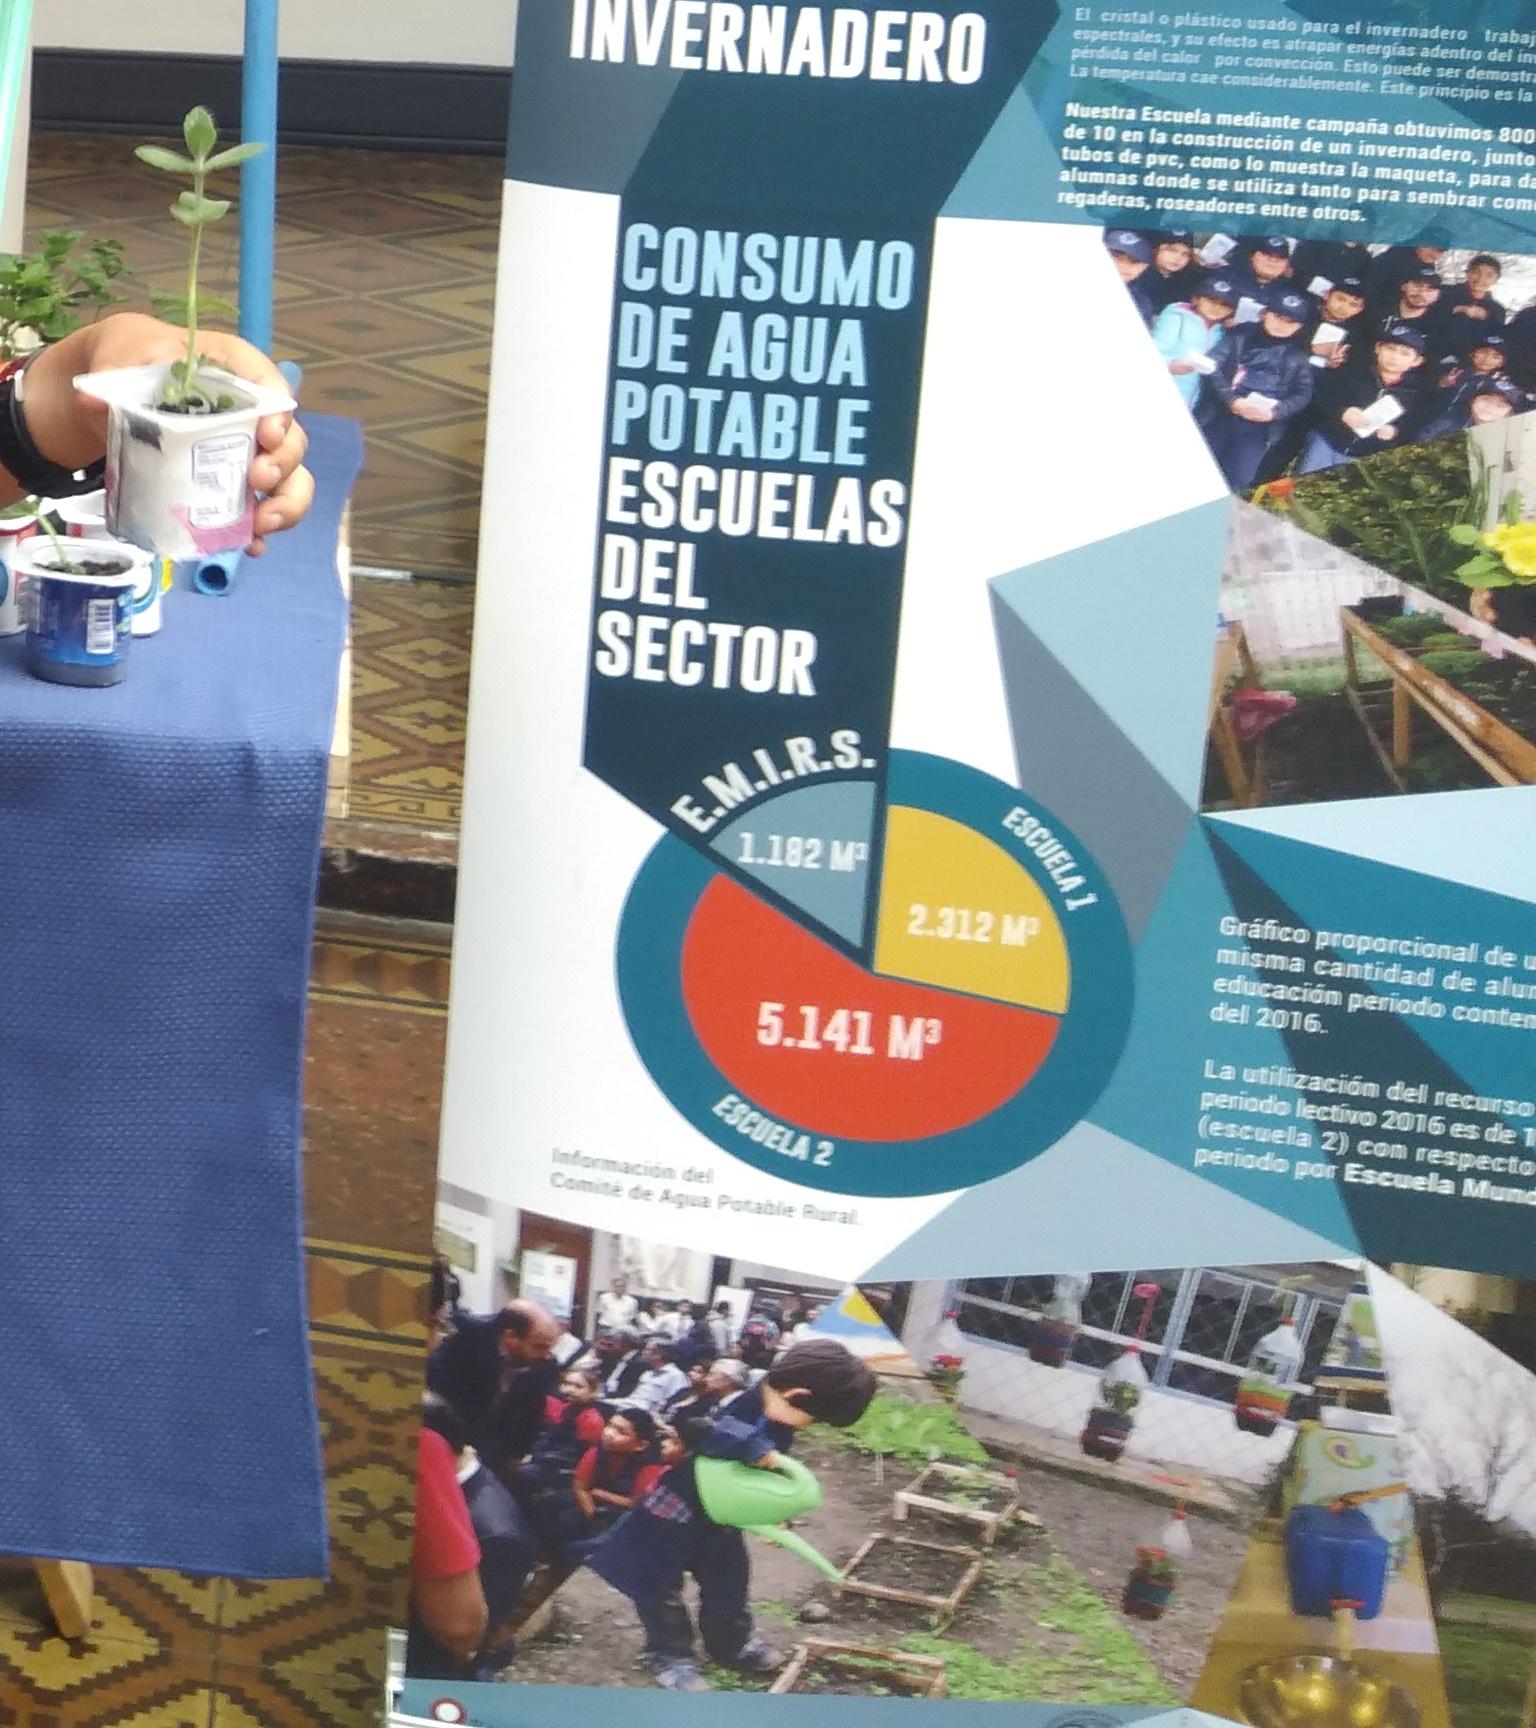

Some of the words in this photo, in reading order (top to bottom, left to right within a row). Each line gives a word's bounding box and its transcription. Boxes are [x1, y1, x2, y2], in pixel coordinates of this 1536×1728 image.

[1064, 123, 1088, 140] de
[1093, 124, 1115, 142] 10
[1121, 130, 1145, 143] en
[1148, 127, 1168, 145] la
[1172, 133, 1294, 151] construcción
[1300, 136, 1324, 154] de
[1328, 142, 1352, 155] un
[1358, 140, 1479, 165] invernadero,
[1483, 147, 1535, 168] junto
[1065, 102, 1136, 121] Nuestra
[1140, 106, 1211, 125] Escuela
[1216, 112, 1302, 130] mediante
[1305, 118, 1388, 136] campaña
[1394, 120, 1494, 141] obtuvimos
[1497, 126, 1536, 144] 800
[1060, 167, 1138, 186] alumnas
[1143, 171, 1202, 190] donde
[1206, 178, 1229, 192] se
[1233, 177, 1296, 196] utiliza
[1300, 181, 1351, 199] tanto
[1356, 188, 1401, 204] para
[1406, 189, 1488, 207] sembrar
[1492, 197, 1536, 211] com
[1062, 145, 1114, 163] tubos
[1118, 148, 1143, 165] de
[1144, 153, 1186, 170] pvc,
[1189, 155, 1240, 170] como
[1245, 155, 1264, 172] lo
[1269, 160, 1346, 177] muestra
[1350, 161, 1370, 179] la
[1374, 167, 1463, 187] maqueta,
[1468, 173, 1511, 189] para
[1058, 190, 1153, 211] regaderas,
[1155, 197, 1258, 215] roseadores
[1260, 203, 1308, 218] entre
[1313, 203, 1367, 222] otros.
[621, 223, 914, 311] CONSUMO
[617, 302, 691, 373] DE
[708, 311, 866, 386] AGUA
[611, 378, 869, 466] POTABLE
[604, 457, 905, 548] ESCUELAS
[601, 534, 707, 609] DEL
[596, 611, 816, 696] SECTOR
[670, 729, 877, 833] E.M.I.R.S.
[739, 833, 822, 868] 1.182
[1000, 806, 1087, 895] ESCUELA
[1067, 889, 1100, 912] 1
[908, 904, 993, 942] 2.312
[1220, 917, 1310, 943] Gráfico
[1315, 931, 1479, 962] proporcional
[1480, 944, 1518, 968] de
[1217, 947, 1306, 973] misma
[1313, 959, 1435, 987] cantidad
[1442, 970, 1478, 993] de
[1210, 1002, 1250, 1025] del
[1213, 976, 1342, 1006] educación
[1347, 992, 1444, 1017] periodo
[758, 1002, 874, 1054] 5.141
[1204, 1059, 1236, 1080] La
[1243, 1067, 1380, 1097] utilización
[1386, 1081, 1429, 1104] del
[1434, 1091, 1531, 1116] recurso
[712, 1094, 811, 1162] ESCUELA
[814, 1141, 833, 1166] 2
[1200, 1092, 1291, 1115] periodo
[1296, 1099, 1376, 1126] lectivo
[1380, 1109, 1446, 1135] 2016
[1449, 1122, 1481, 1140] es
[1484, 1122, 1518, 1145] de
[550, 1149, 676, 1180] Información
[683, 1167, 713, 1183] del
[1198, 1116, 1311, 1147] (escuela
[1321, 1130, 1350, 1156] 2)
[1356, 1139, 1407, 1160] con
[1415, 1147, 1533, 1175] respecto
[550, 1172, 623, 1196] Comité
[630, 1185, 654, 1201] de
[659, 1189, 711, 1209] Agua
[718, 1195, 794, 1217] Potable
[1194, 1148, 1286, 1172] periodo
[1293, 1161, 1340, 1180] por
[1343, 1162, 1455, 1195] Escuela
